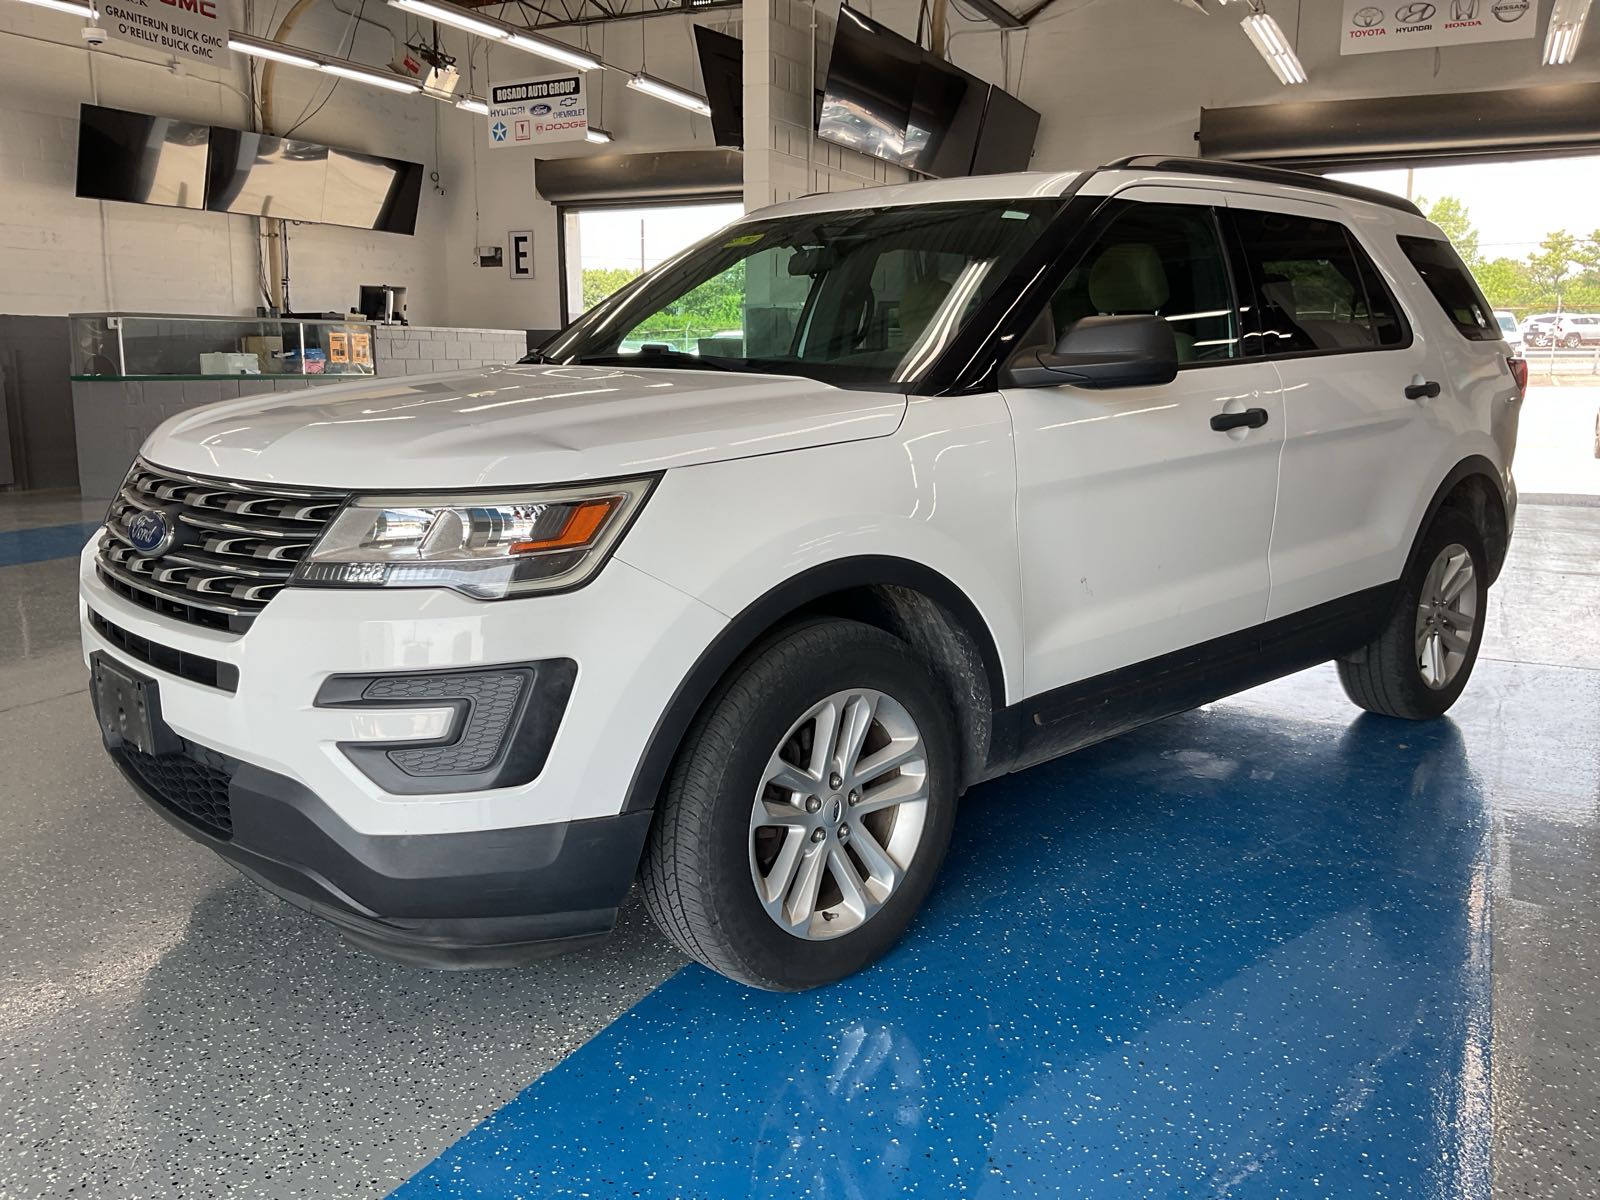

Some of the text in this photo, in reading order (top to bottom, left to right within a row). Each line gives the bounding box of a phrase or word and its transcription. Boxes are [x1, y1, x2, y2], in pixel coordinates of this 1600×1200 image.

[105, 5, 223, 48] GRANITERUN BUICK GMC
[1396, 24, 1433, 34] HYUNDAI
[1444, 20, 1483, 29] HONDA
[1350, 28, 1386, 38] TOYOTA
[118, 23, 213, 59] O'REILLY BUICK GMC
[496, 80, 576, 101] ROSADO AUTO GROUP
[490, 106, 526, 117] HYUNDAI
[553, 109, 585, 119] CHEVROLET
[545, 121, 587, 131] DODGE
[514, 236, 529, 274] E
[131, 515, 157, 543] Ford
